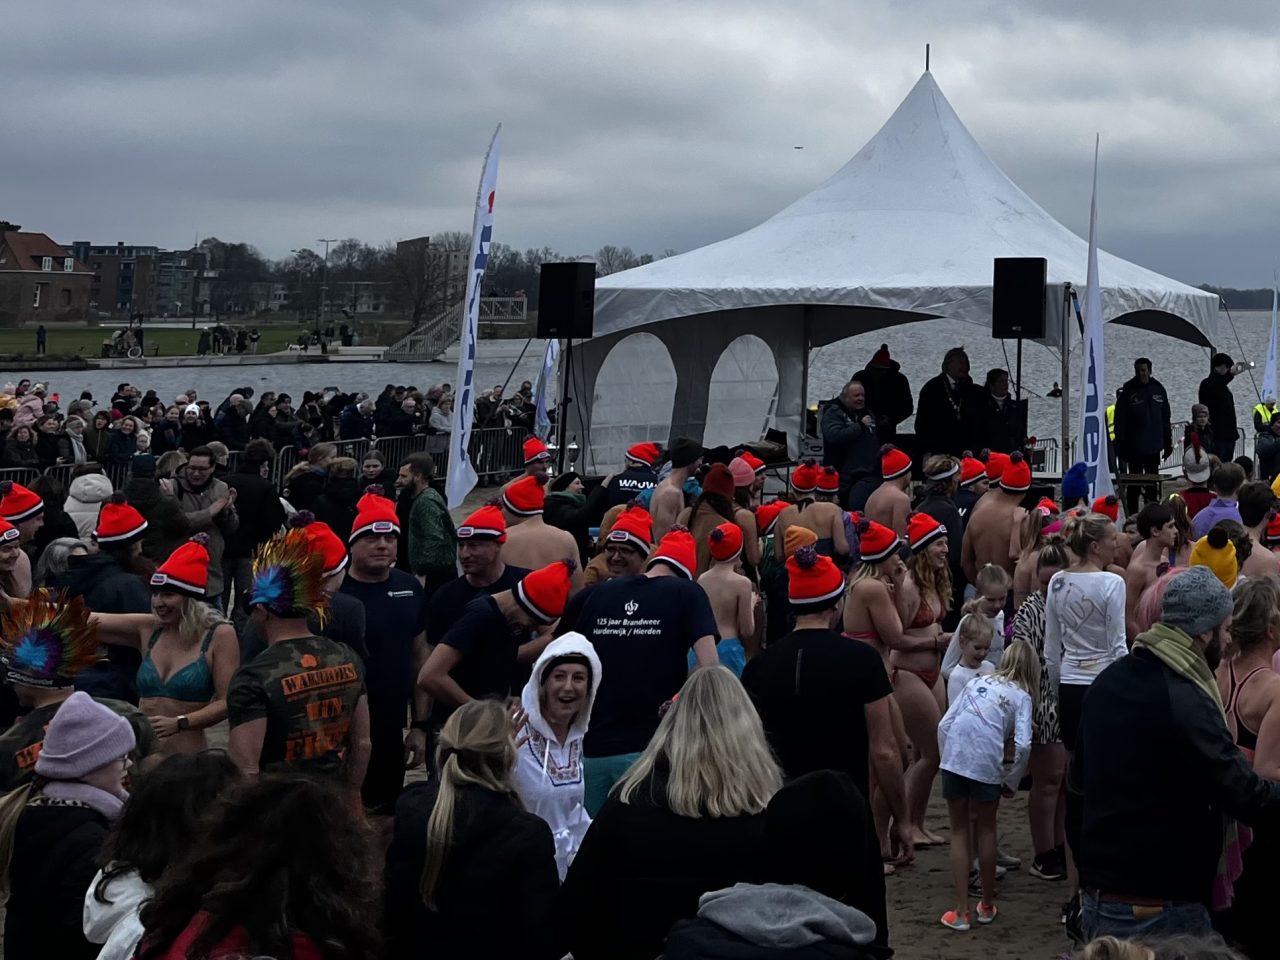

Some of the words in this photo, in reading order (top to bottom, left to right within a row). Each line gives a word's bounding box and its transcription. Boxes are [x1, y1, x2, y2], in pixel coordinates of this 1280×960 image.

[597, 618, 607, 626] 125
[608, 618, 621, 626] jaar
[623, 618, 661, 626] Brandweer
[633, 627, 662, 636] Hierden
